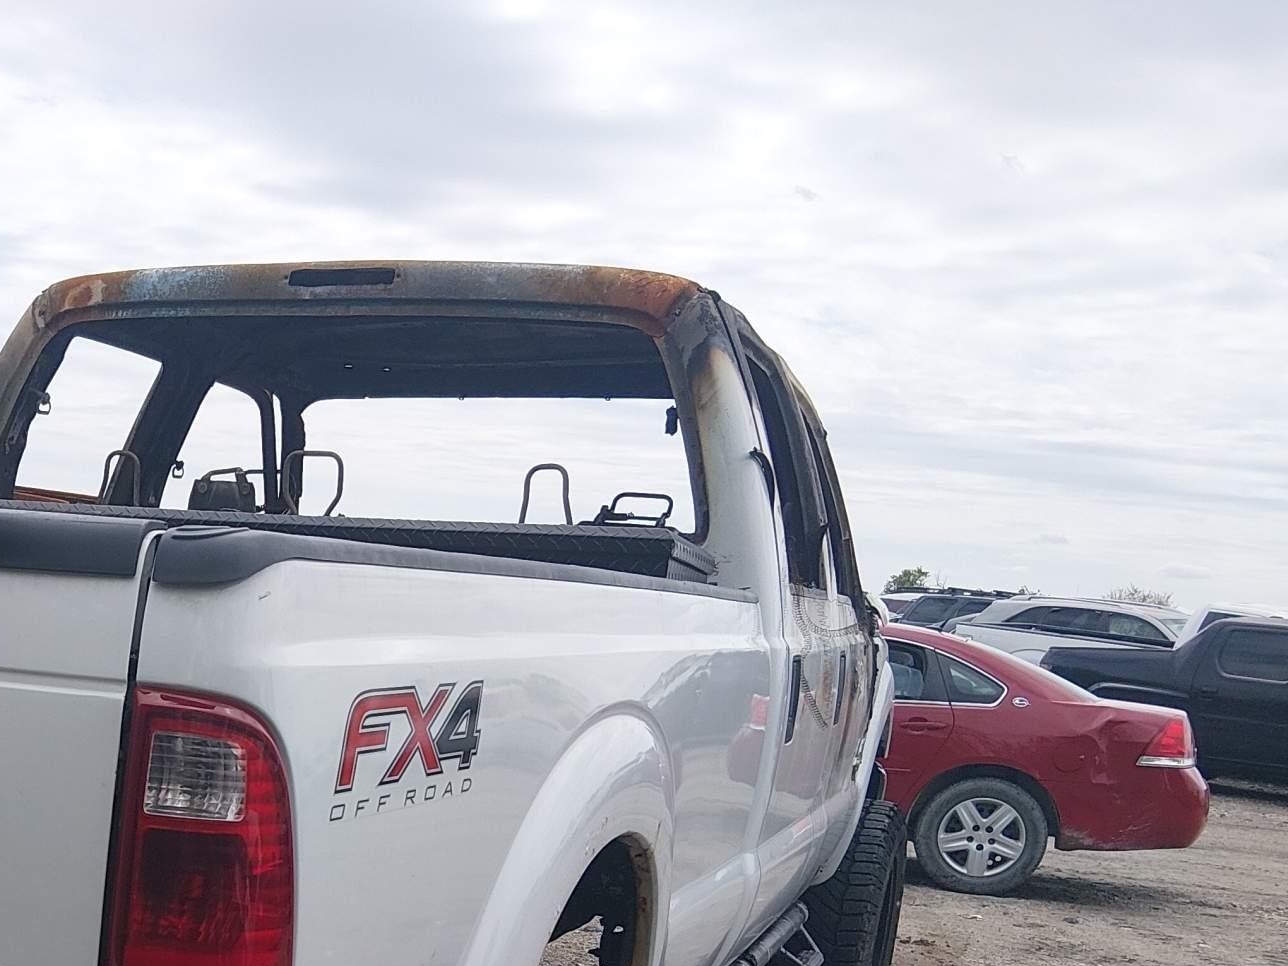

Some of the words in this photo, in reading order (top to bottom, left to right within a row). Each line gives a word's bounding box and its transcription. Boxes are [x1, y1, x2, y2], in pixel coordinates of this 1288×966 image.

[334, 679, 485, 794] FX4
[329, 794, 391, 822] OFF
[404, 777, 473, 807] ROAD
